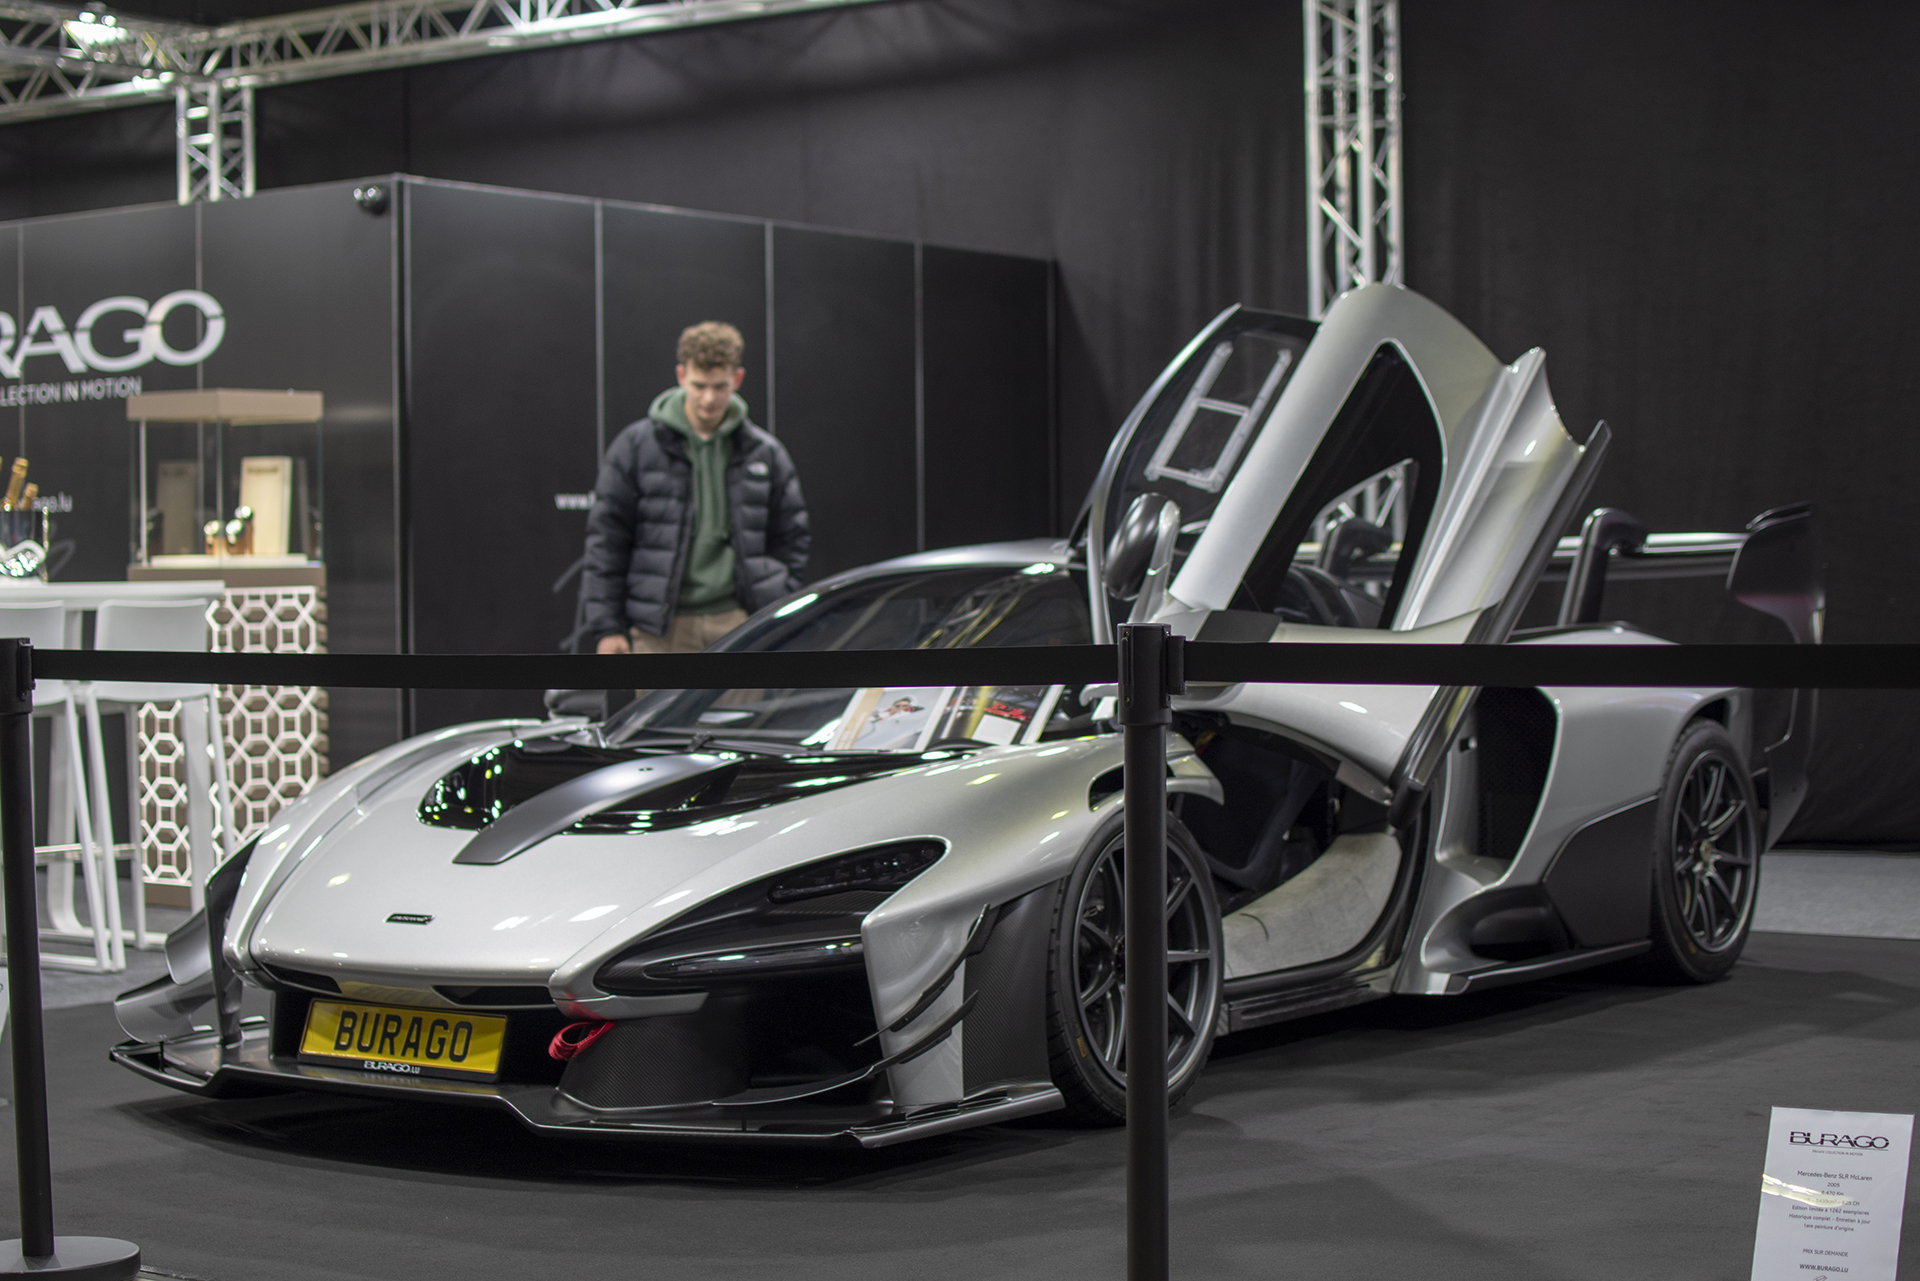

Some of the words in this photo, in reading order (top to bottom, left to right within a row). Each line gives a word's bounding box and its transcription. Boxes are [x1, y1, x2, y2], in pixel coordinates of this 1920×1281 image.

[62, 380, 79, 402] IN
[80, 376, 142, 400] MOTION
[334, 1010, 473, 1063] BURAGO
[1789, 1131, 1889, 1149] BURAGO
[1797, 1170, 1837, 1179] Mercedes-Benz
[1799, 1263, 1849, 1273] WWW.BURAGO.LU
